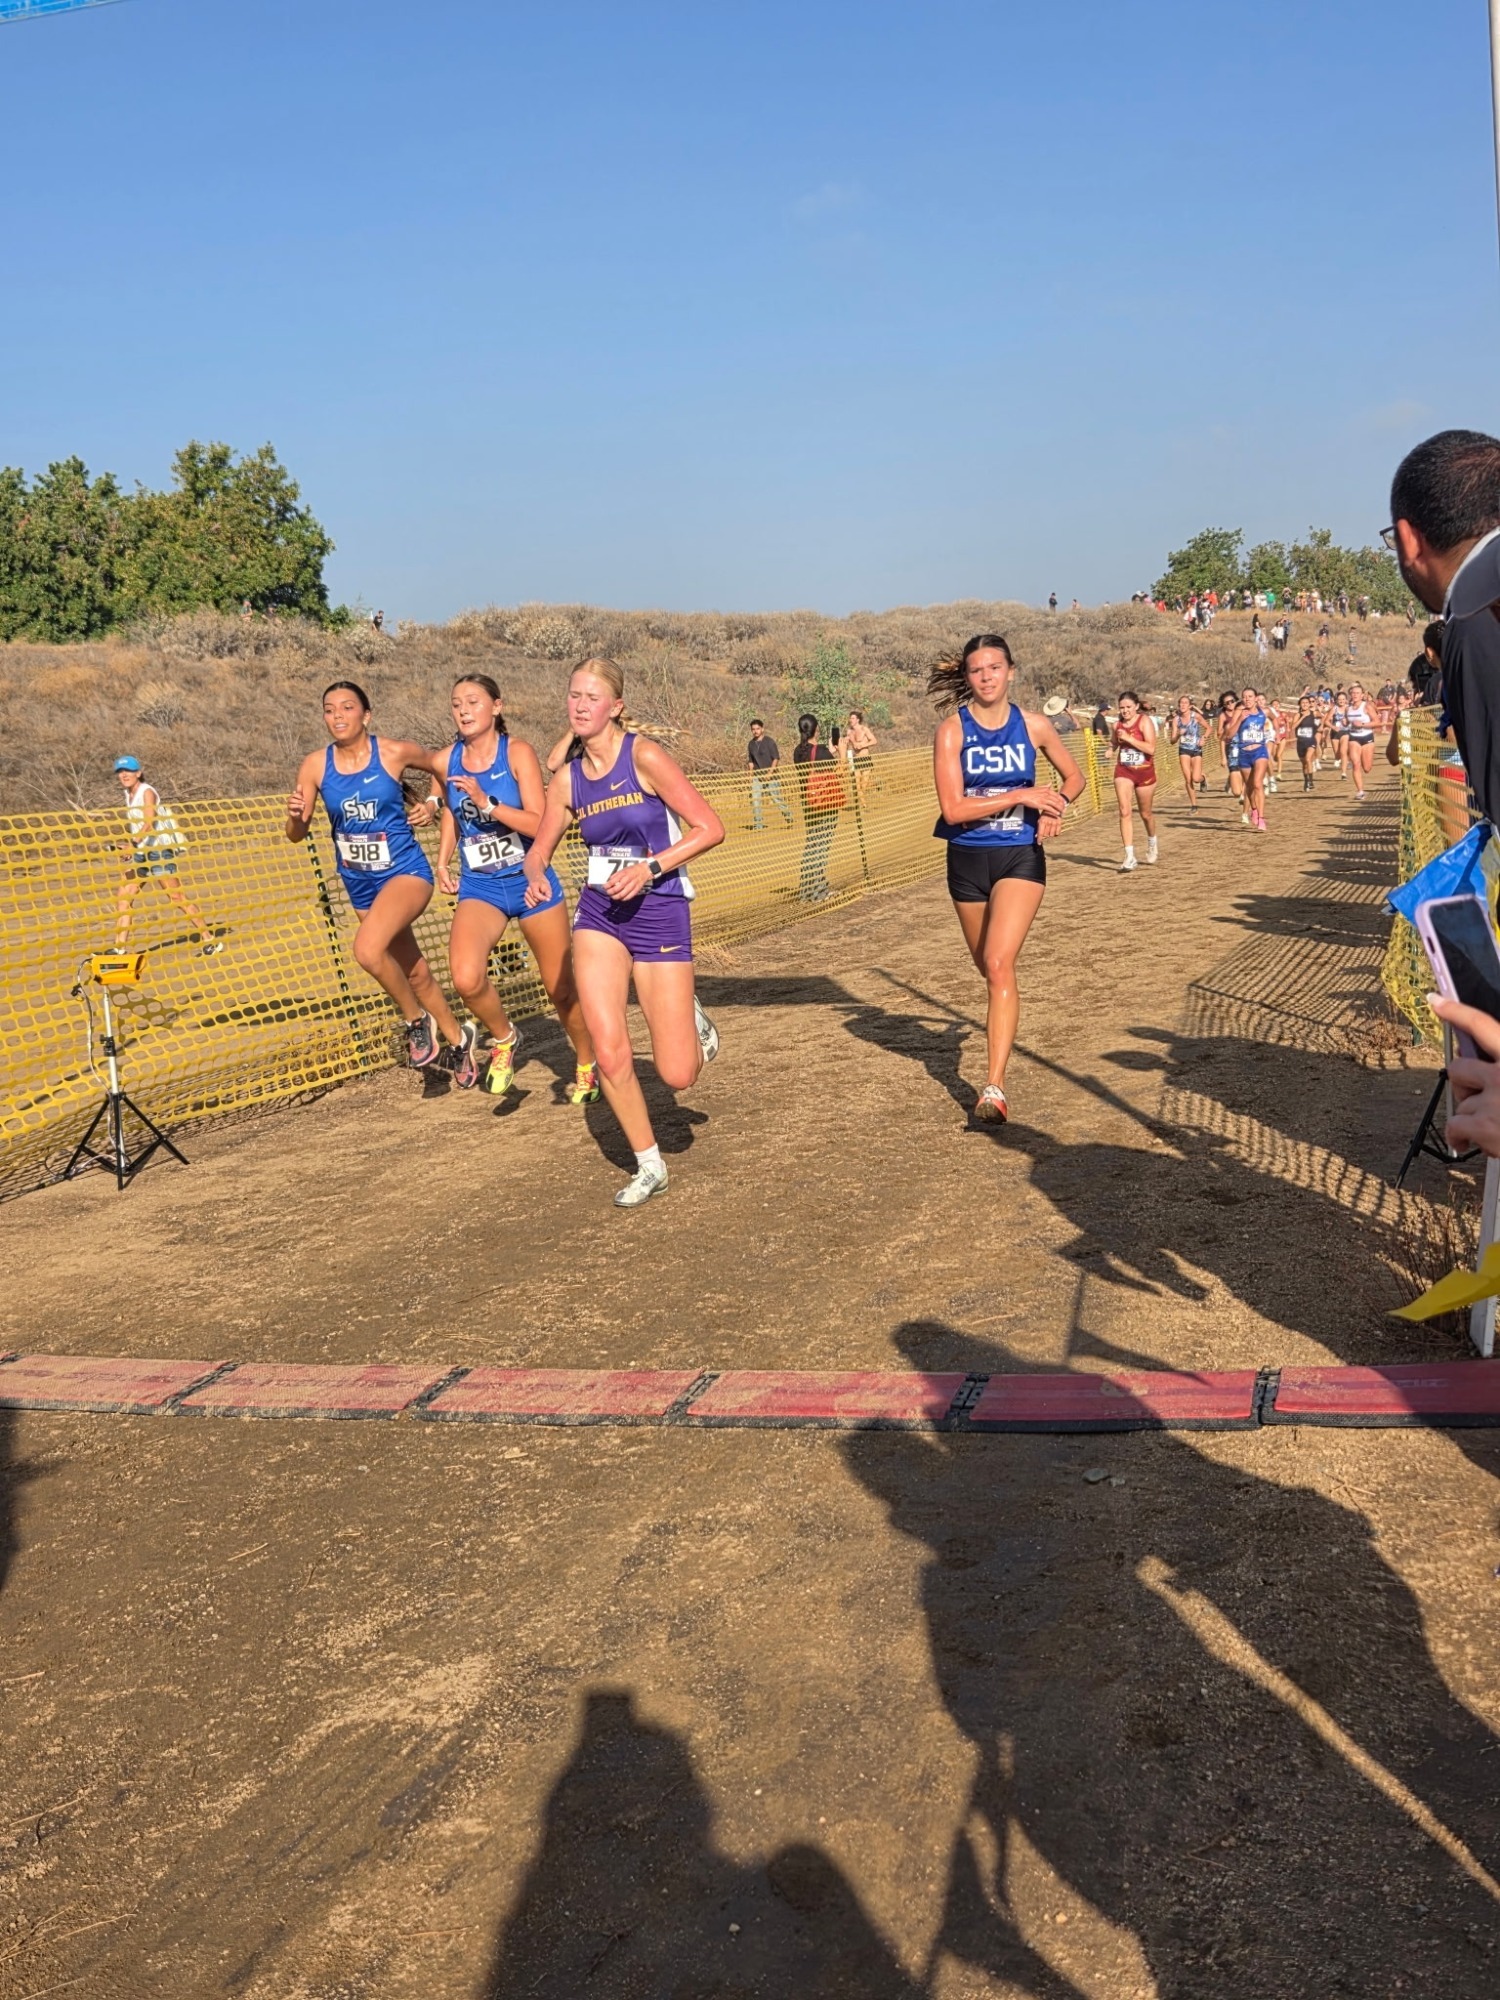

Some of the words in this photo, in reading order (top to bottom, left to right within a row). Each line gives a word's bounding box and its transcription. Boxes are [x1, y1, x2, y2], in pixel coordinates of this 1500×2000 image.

[966, 744, 1026, 774] CSN
[1125, 752, 1141, 762] 313
[342, 797, 377, 822] SM
[576, 807, 586, 820] AL
[587, 792, 644, 817] LUTHERAN
[349, 843, 380, 861] 918
[478, 837, 514, 863] 912
[607, 859, 640, 882] 7
